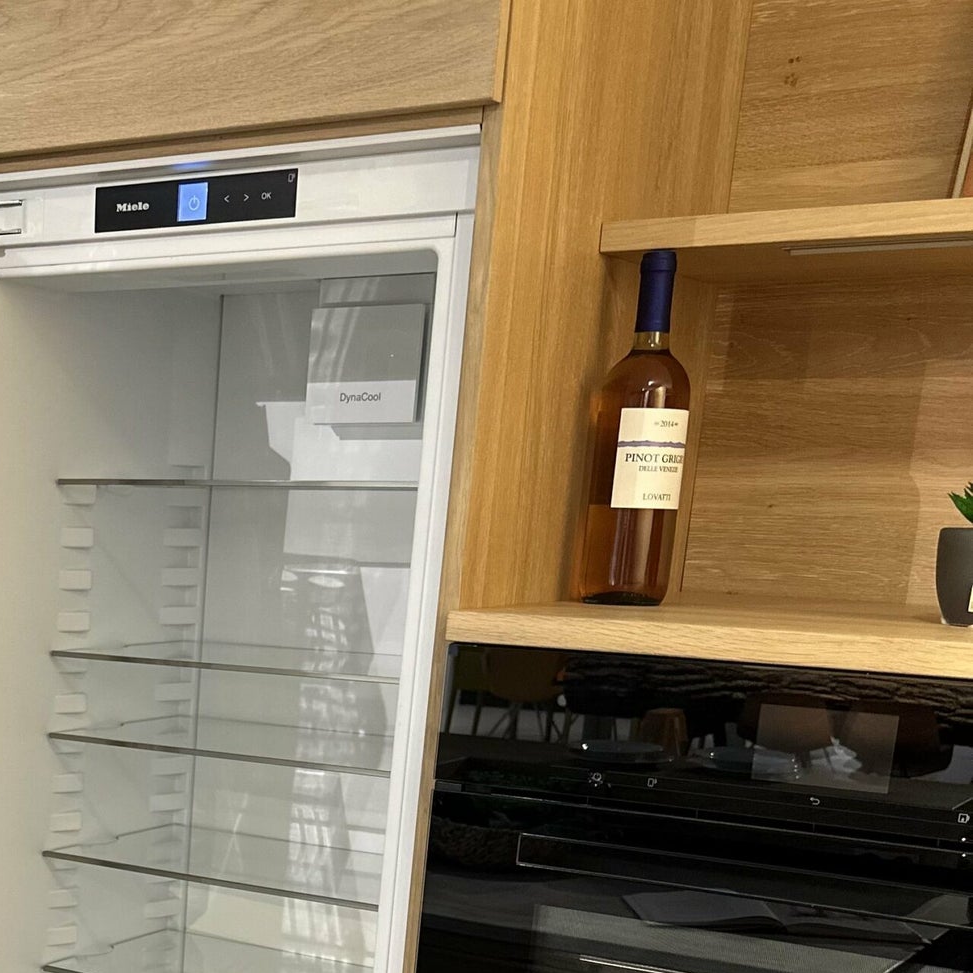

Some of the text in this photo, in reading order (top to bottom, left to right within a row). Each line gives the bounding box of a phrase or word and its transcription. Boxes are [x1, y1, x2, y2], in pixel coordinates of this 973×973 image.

[261, 191, 272, 200] OK
[116, 201, 150, 212] Miele
[339, 392, 381, 404] DynaCool
[625, 453, 660, 463] PINOT
[642, 493, 671, 501] LOVATTI
